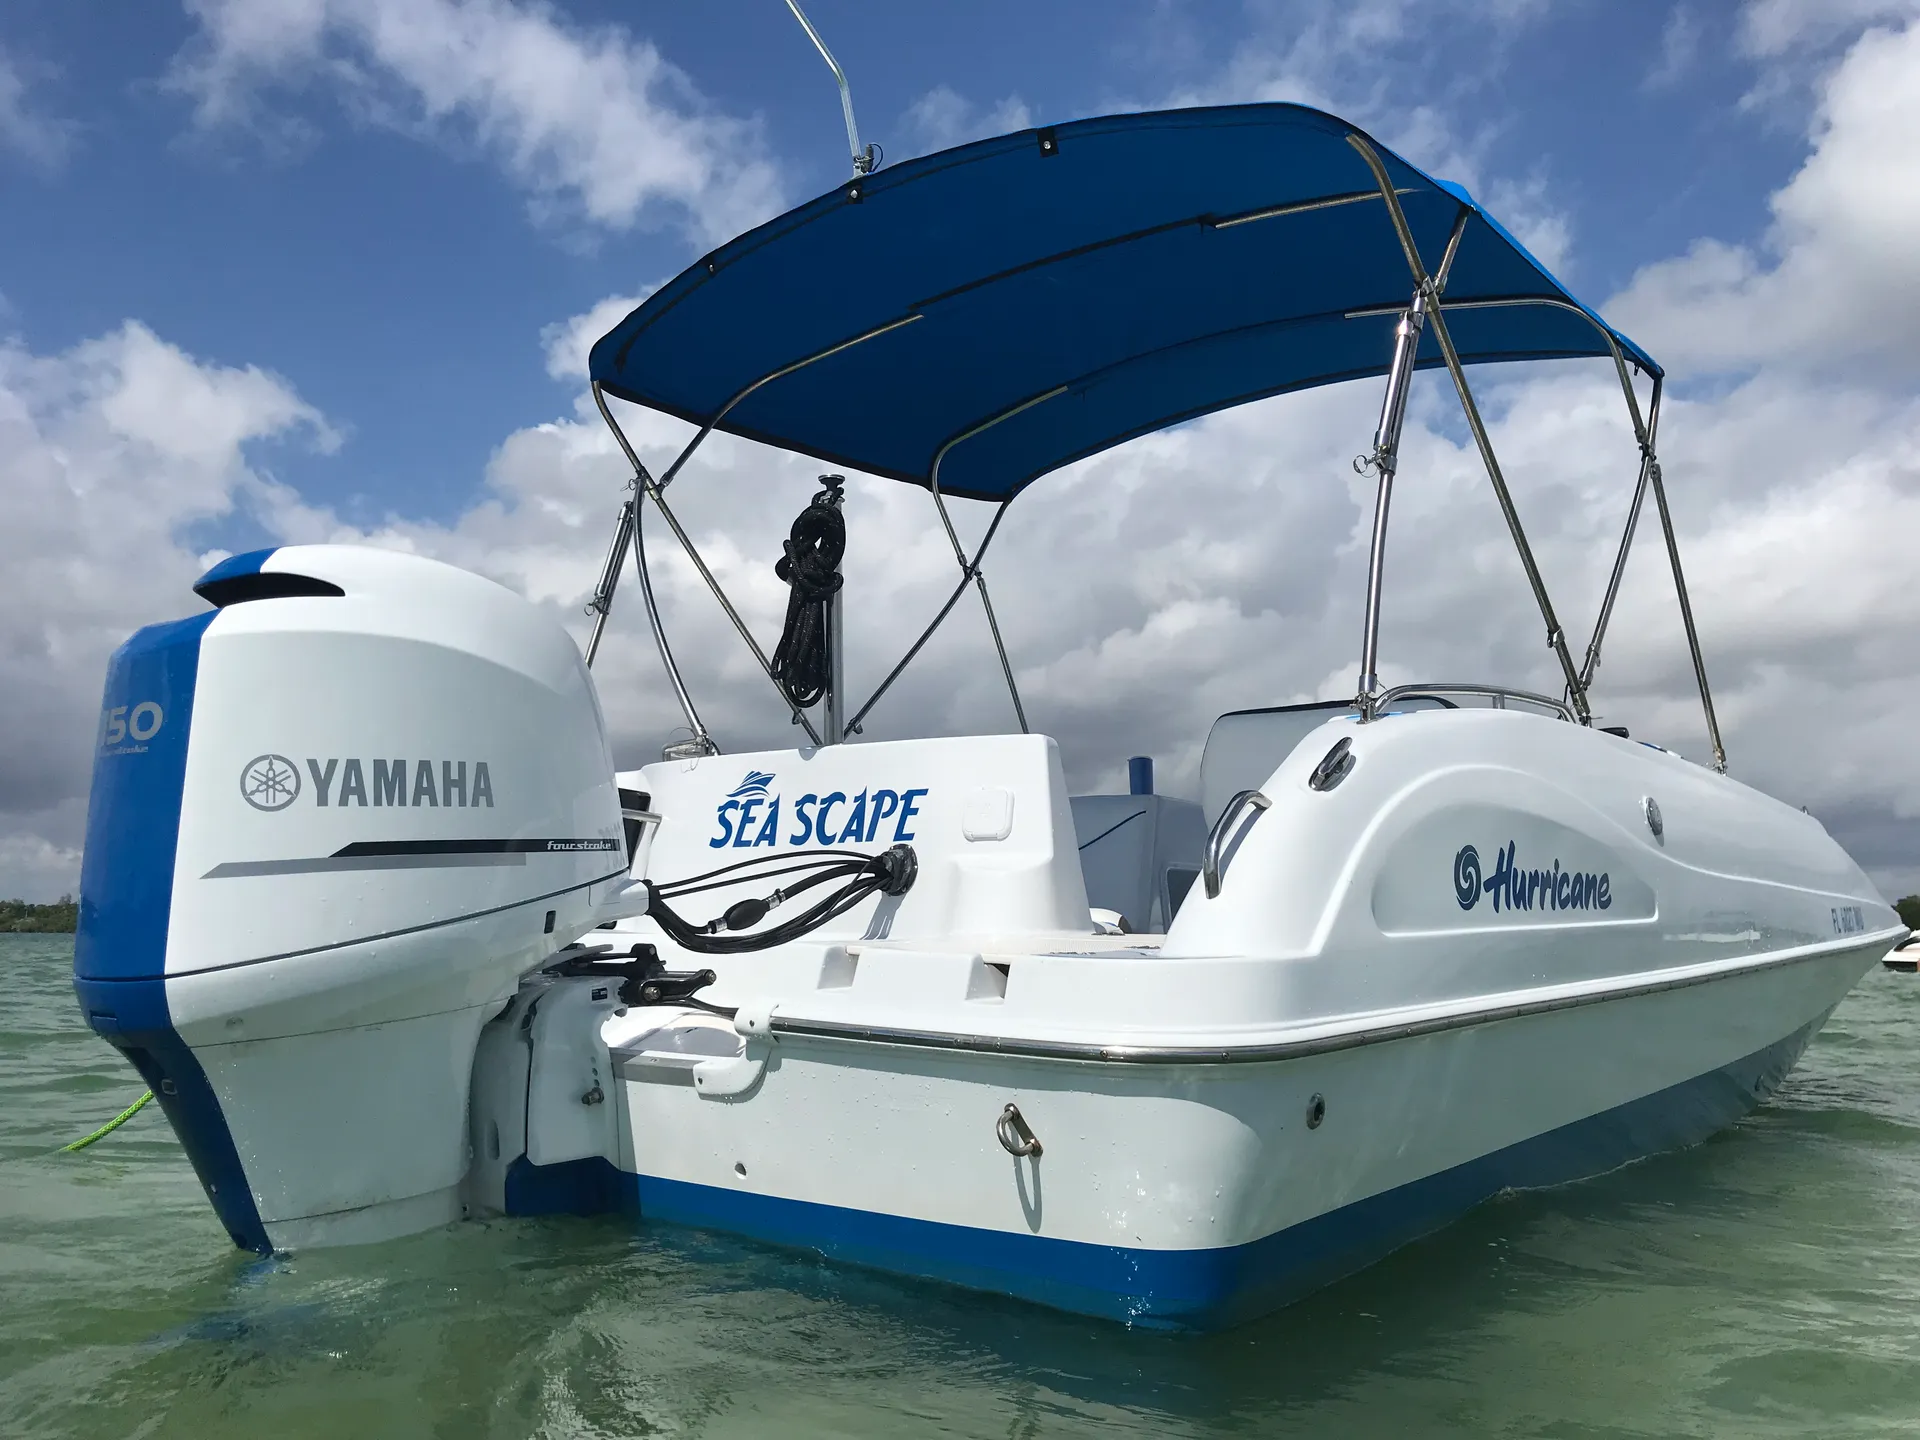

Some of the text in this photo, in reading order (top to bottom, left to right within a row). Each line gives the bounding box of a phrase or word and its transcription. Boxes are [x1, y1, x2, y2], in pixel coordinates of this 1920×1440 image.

[306, 758, 495, 808] YAMAHA
[709, 785, 929, 849] SEA SCAPE
[1483, 839, 1612, 914] Hurricane
